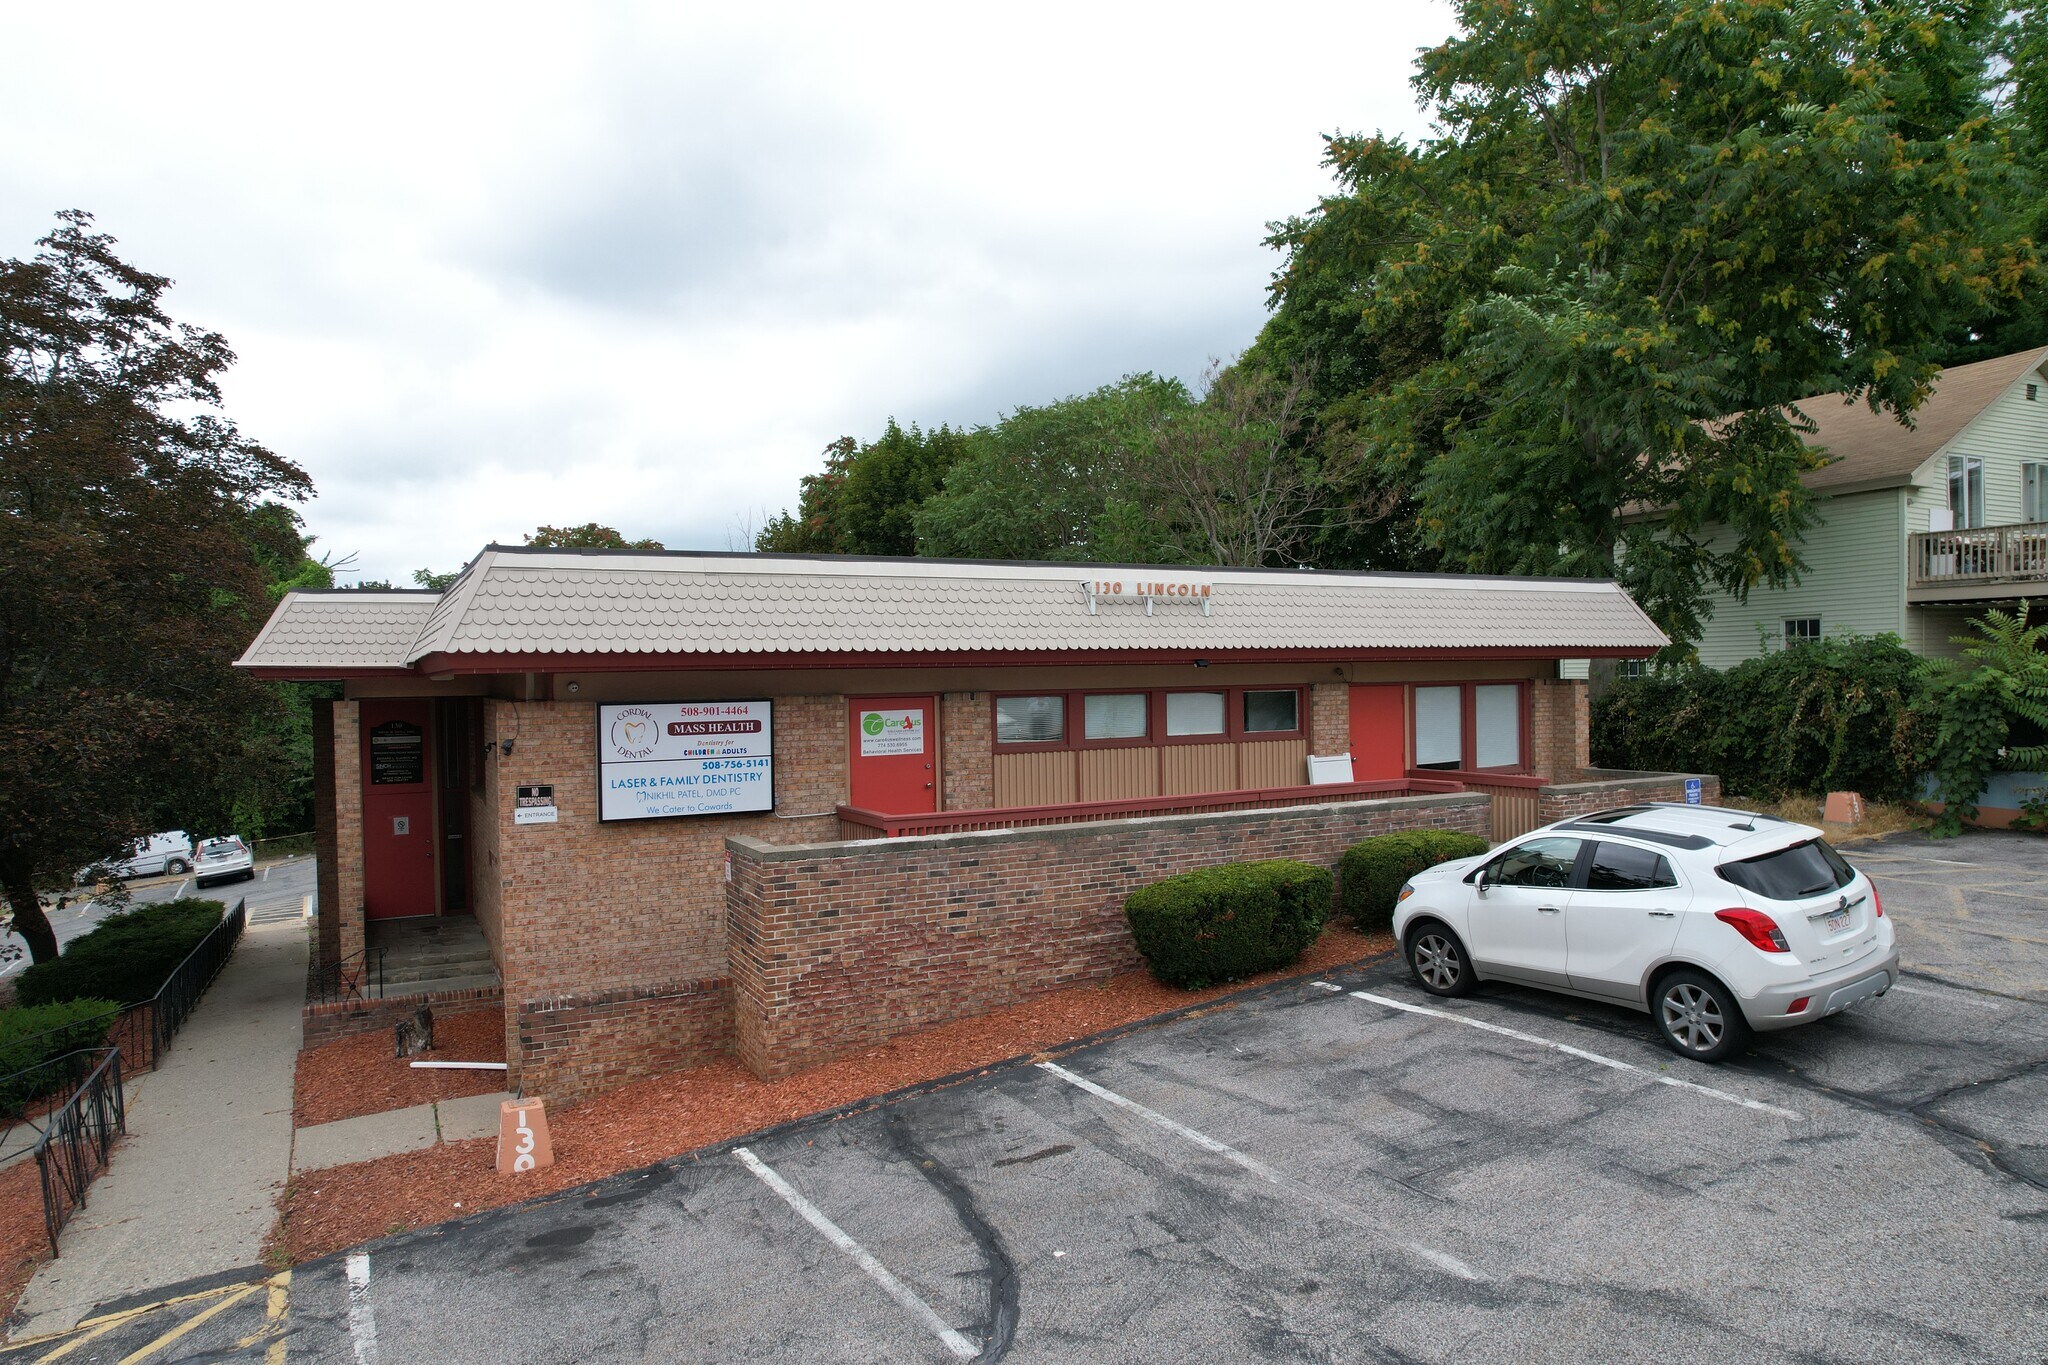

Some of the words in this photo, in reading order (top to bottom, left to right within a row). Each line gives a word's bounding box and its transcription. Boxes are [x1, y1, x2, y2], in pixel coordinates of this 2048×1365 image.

[1096, 582, 1122, 594] 130
[1137, 582, 1211, 597] LINCOLN
[617, 708, 652, 721] CORDIAL
[681, 706, 748, 716] 508-901-4464
[674, 724, 706, 733] MASS
[709, 722, 754, 732] HEALTH
[617, 746, 653, 758] DENTAL
[702, 759, 769, 770] 508-756-5141
[612, 778, 646, 789] LASER
[650, 778, 657, 787] &
[661, 775, 700, 786] FAMILY
[702, 772, 763, 784] DENTISTRY
[532, 788, 539, 796] NO
[647, 791, 675, 800] NIKHIL
[678, 790, 703, 799] PATEL,
[706, 788, 727, 797] DMD
[730, 788, 741, 796] PC
[519, 796, 552, 806] TRESPASSING
[646, 806, 660, 814] We
[662, 805, 684, 813] Cater
[698, 802, 733, 811] Cowards
[514, 1110, 535, 1172] 130
